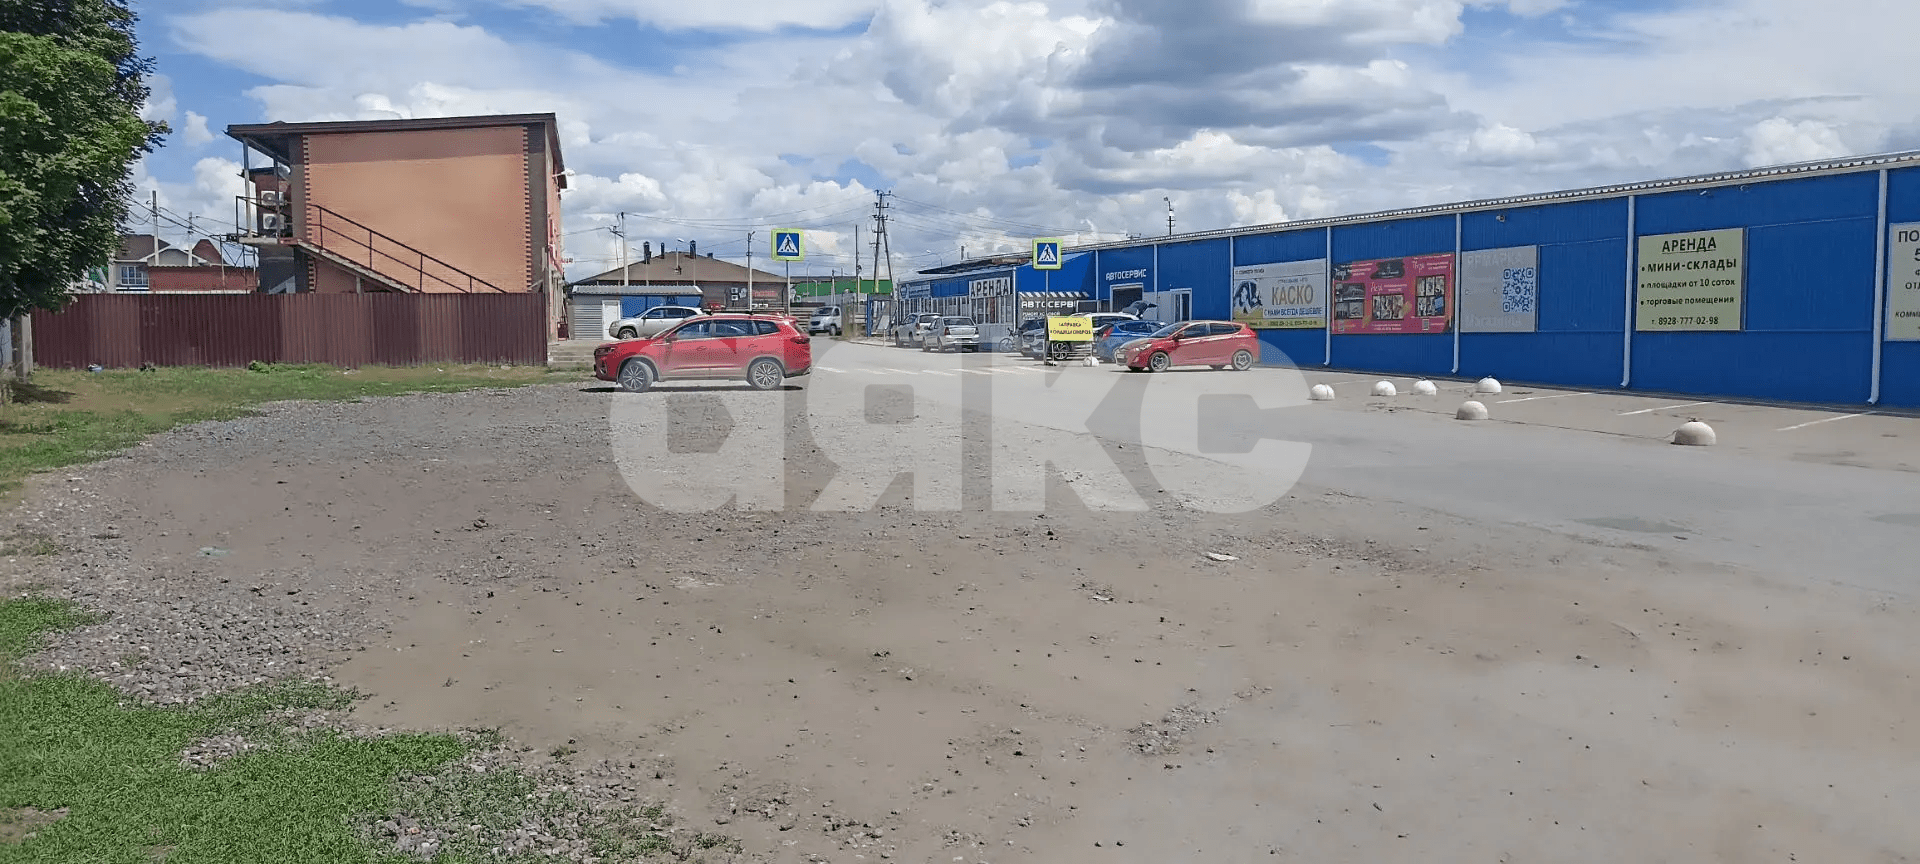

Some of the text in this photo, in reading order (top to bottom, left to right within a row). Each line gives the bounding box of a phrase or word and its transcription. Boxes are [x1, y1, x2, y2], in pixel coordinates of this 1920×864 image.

[1662, 237, 1717, 253] АРЕНДА
[1105, 268, 1147, 281] АВТОСЕРВИС
[970, 278, 1010, 298] АРЕНДА
[1647, 281, 1687, 289] площадки
[1699, 278, 1710, 287] 10
[1711, 279, 1735, 287] соток
[1271, 283, 1314, 306] КАСКО
[1646, 297, 1735, 307] торговые помещения
[1658, 316, 1719, 325] 8928-777-02-98
